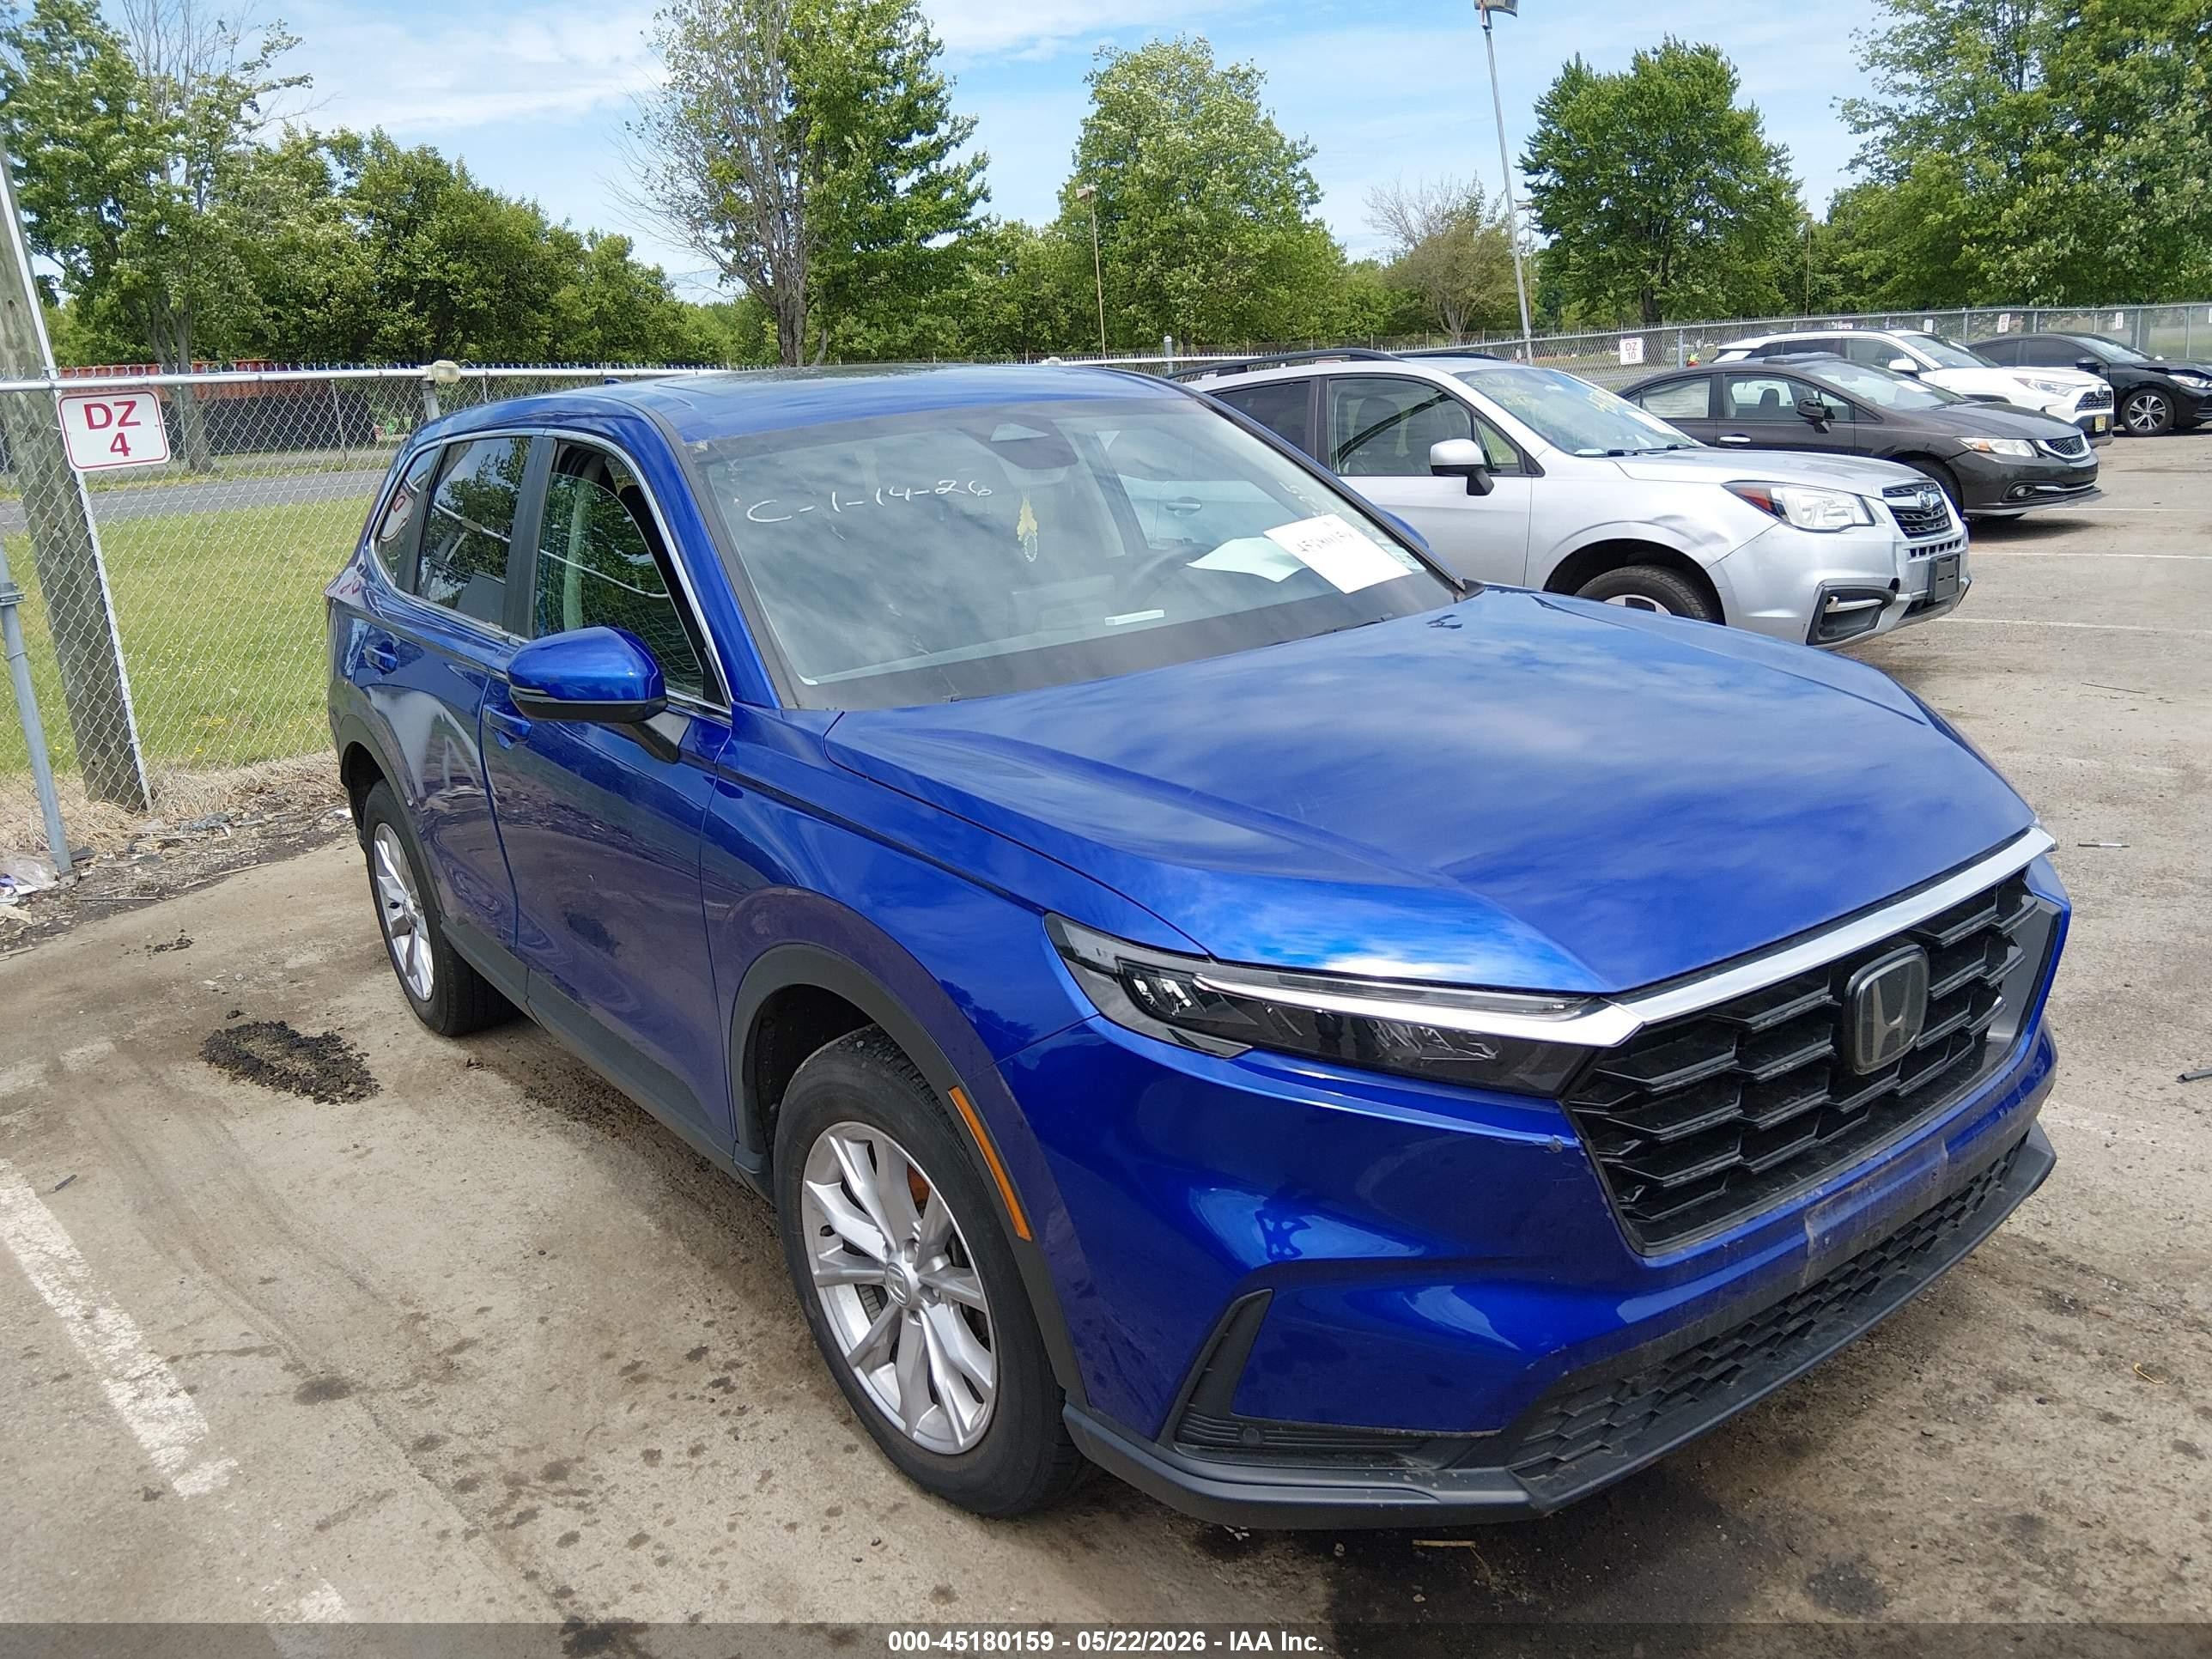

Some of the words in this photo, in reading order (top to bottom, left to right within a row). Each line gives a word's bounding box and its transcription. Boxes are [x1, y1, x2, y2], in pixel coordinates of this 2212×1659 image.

[1625, 342, 1638, 351] DZ
[83, 400, 141, 429] DZ
[110, 432, 131, 457] 4
